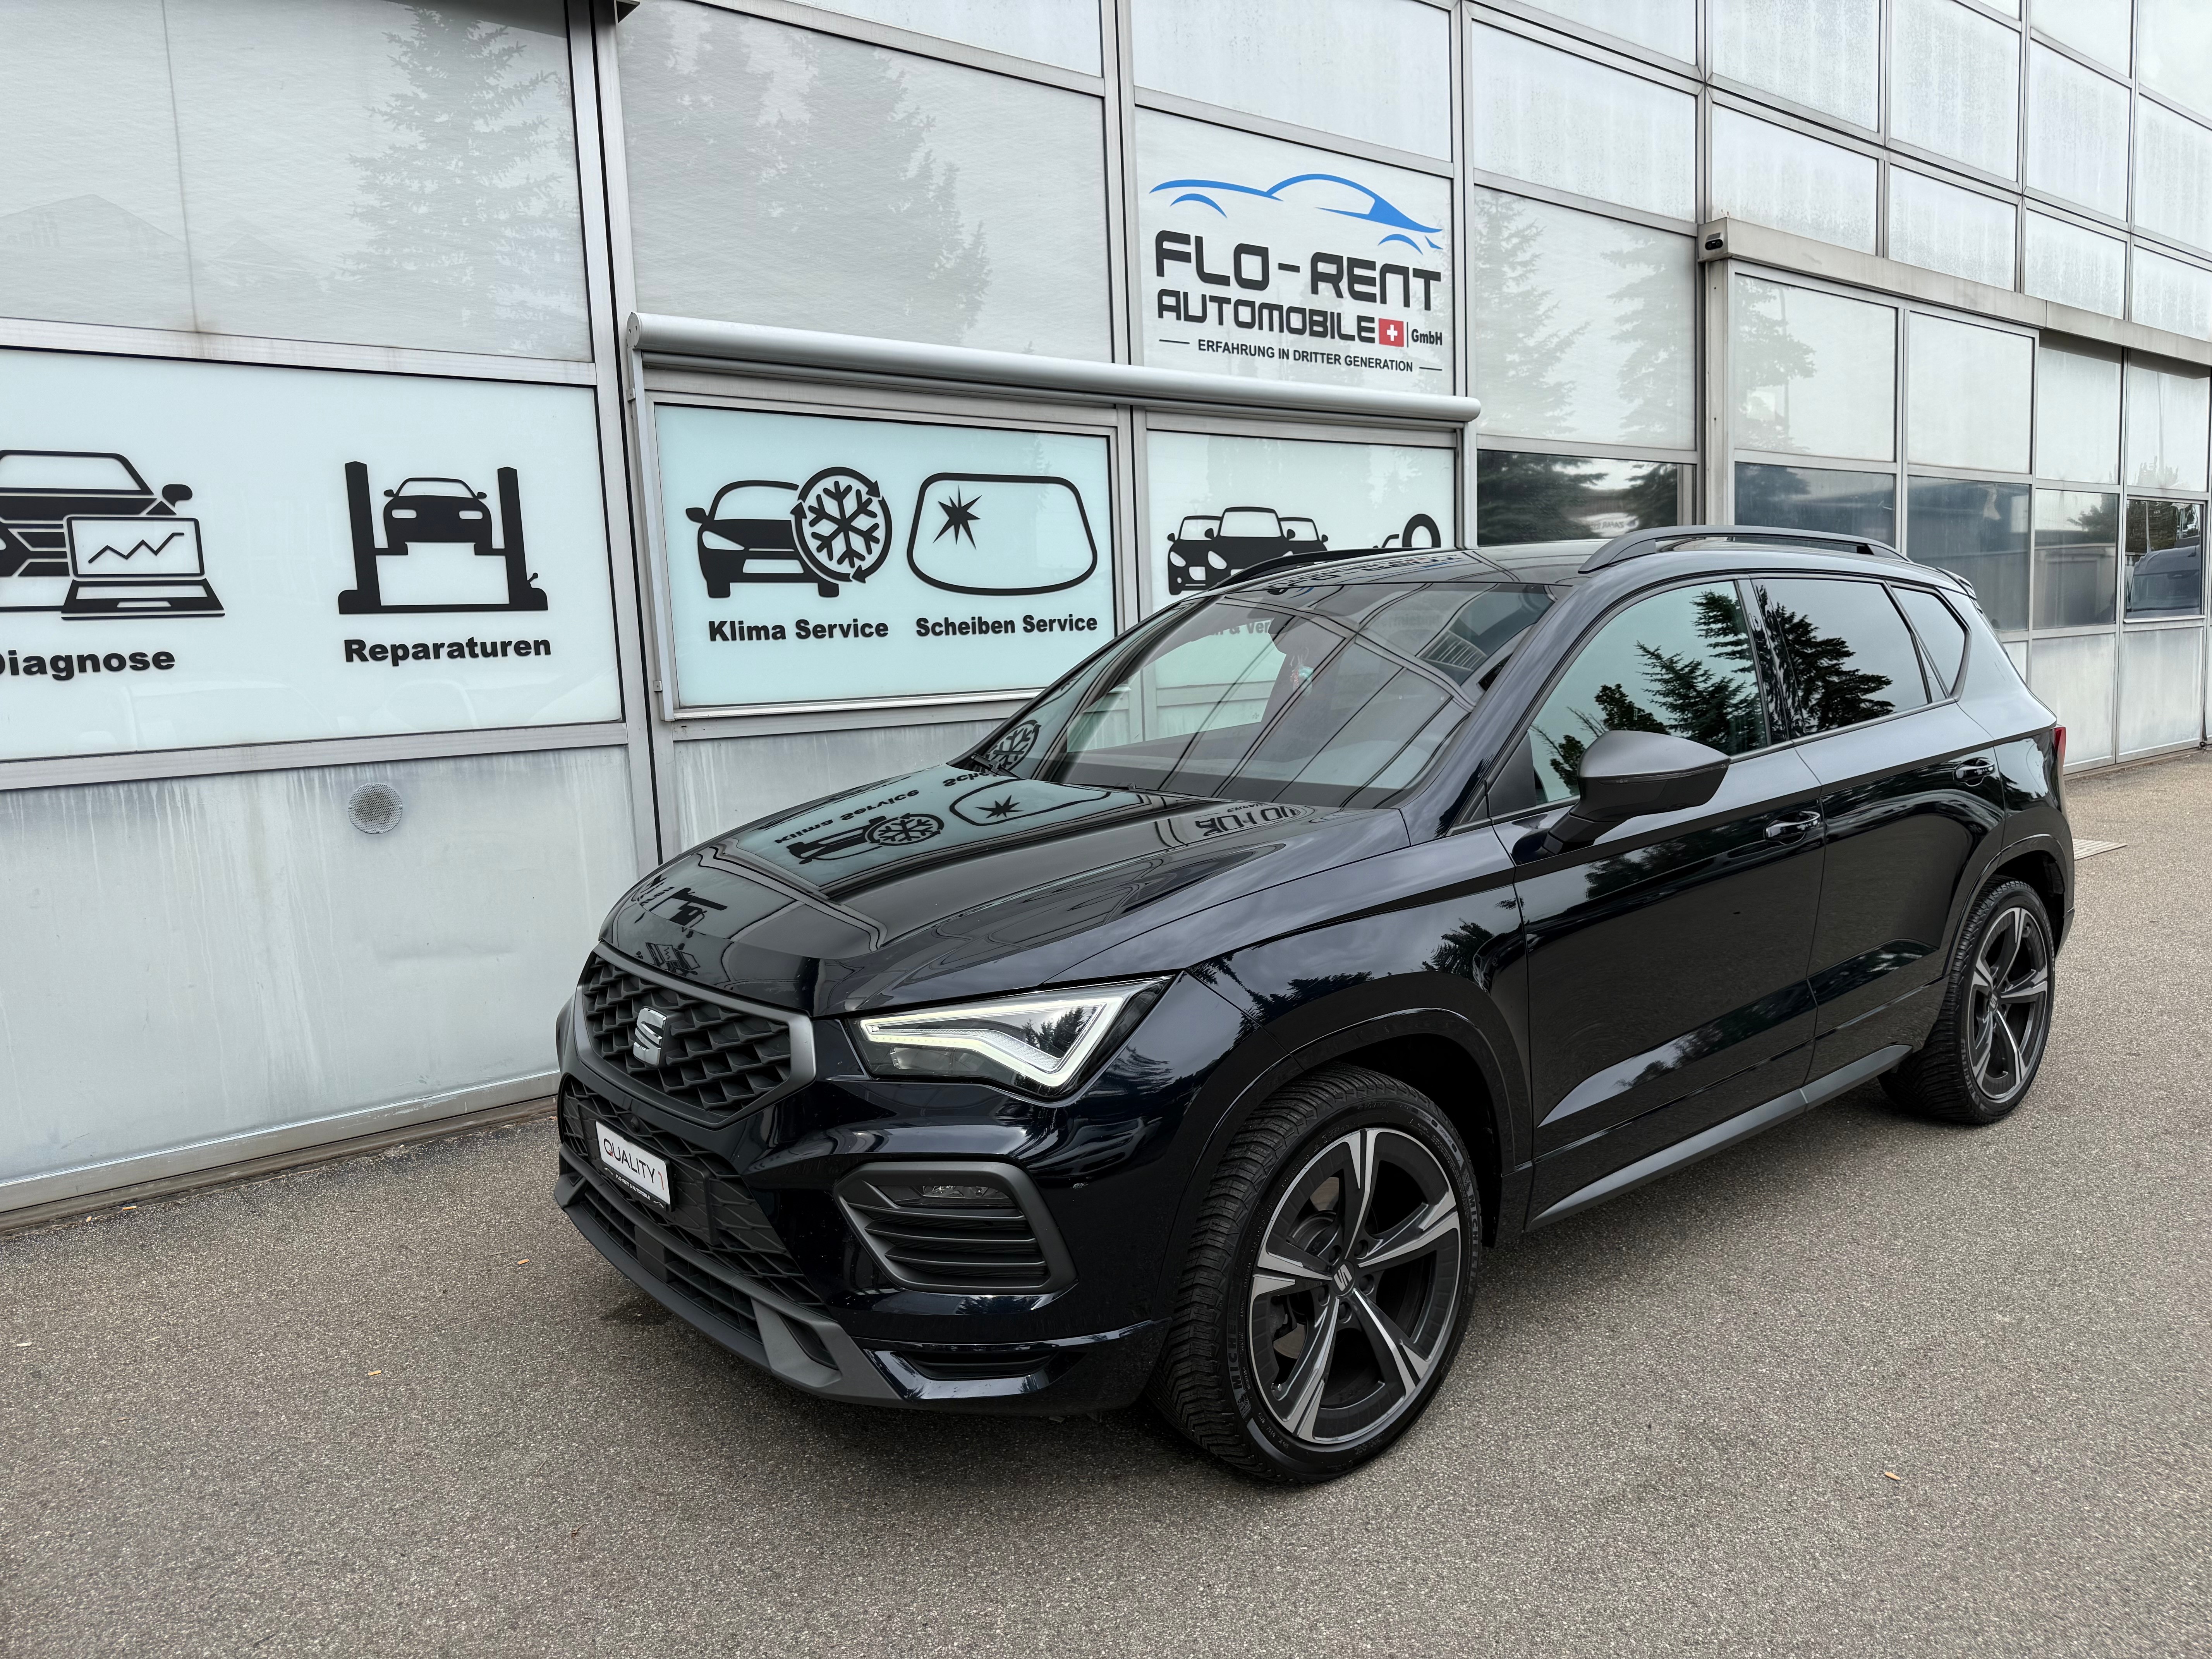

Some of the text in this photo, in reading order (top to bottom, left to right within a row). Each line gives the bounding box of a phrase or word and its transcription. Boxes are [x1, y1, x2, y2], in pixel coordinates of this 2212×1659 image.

[1158, 289, 1443, 345] AUTOMOBILE GmbH
[1199, 339, 1413, 372] ERFAHRUNG IN DRITTER GENERATION
[709, 618, 889, 641] Klima Service
[916, 614, 1097, 637] Scheiben Service
[0, 650, 175, 681] iagnose
[344, 637, 551, 667] Reparaturen
